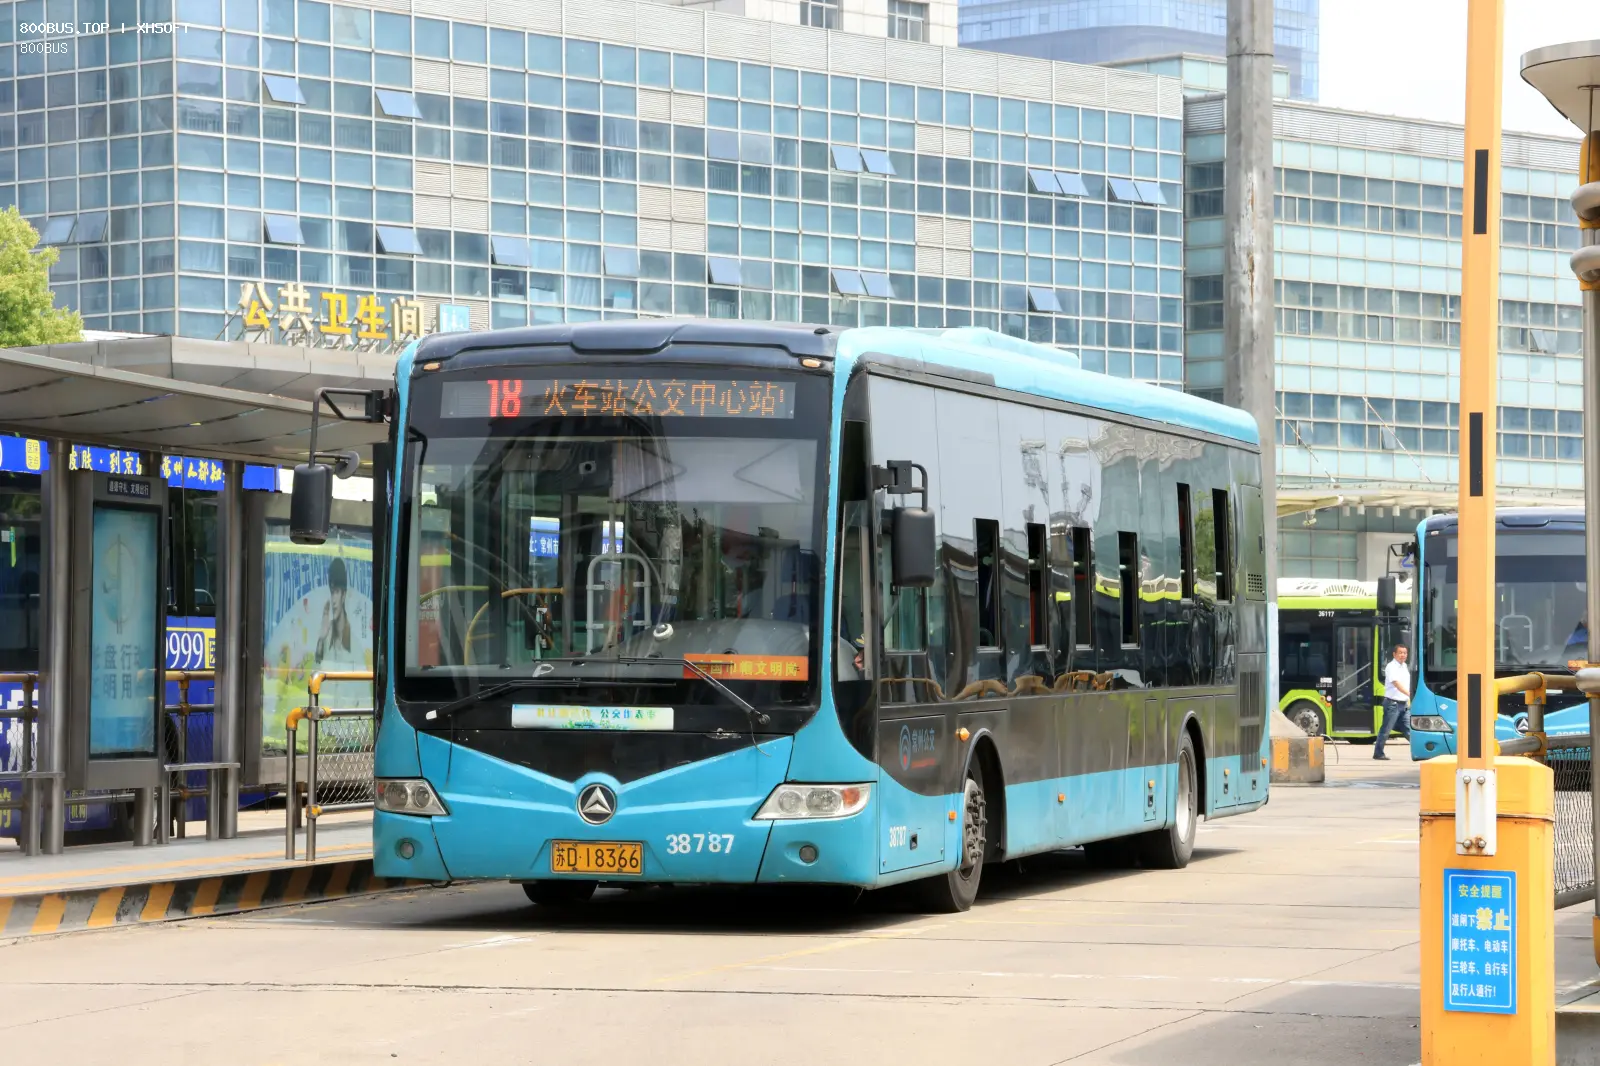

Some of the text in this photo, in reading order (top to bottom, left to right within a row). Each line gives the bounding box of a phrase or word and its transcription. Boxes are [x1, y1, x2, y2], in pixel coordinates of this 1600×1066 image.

[238, 282, 425, 342] 公共卫生间
[487, 379, 522, 418] 18
[544, 378, 785, 418] 火车站公交中心站
[165, 632, 204, 669] 999
[911, 727, 936, 753] 常州公交
[665, 833, 735, 855] 38787
[889, 825, 907, 848] 38787
[1458, 883, 1503, 899] 安全提醒
